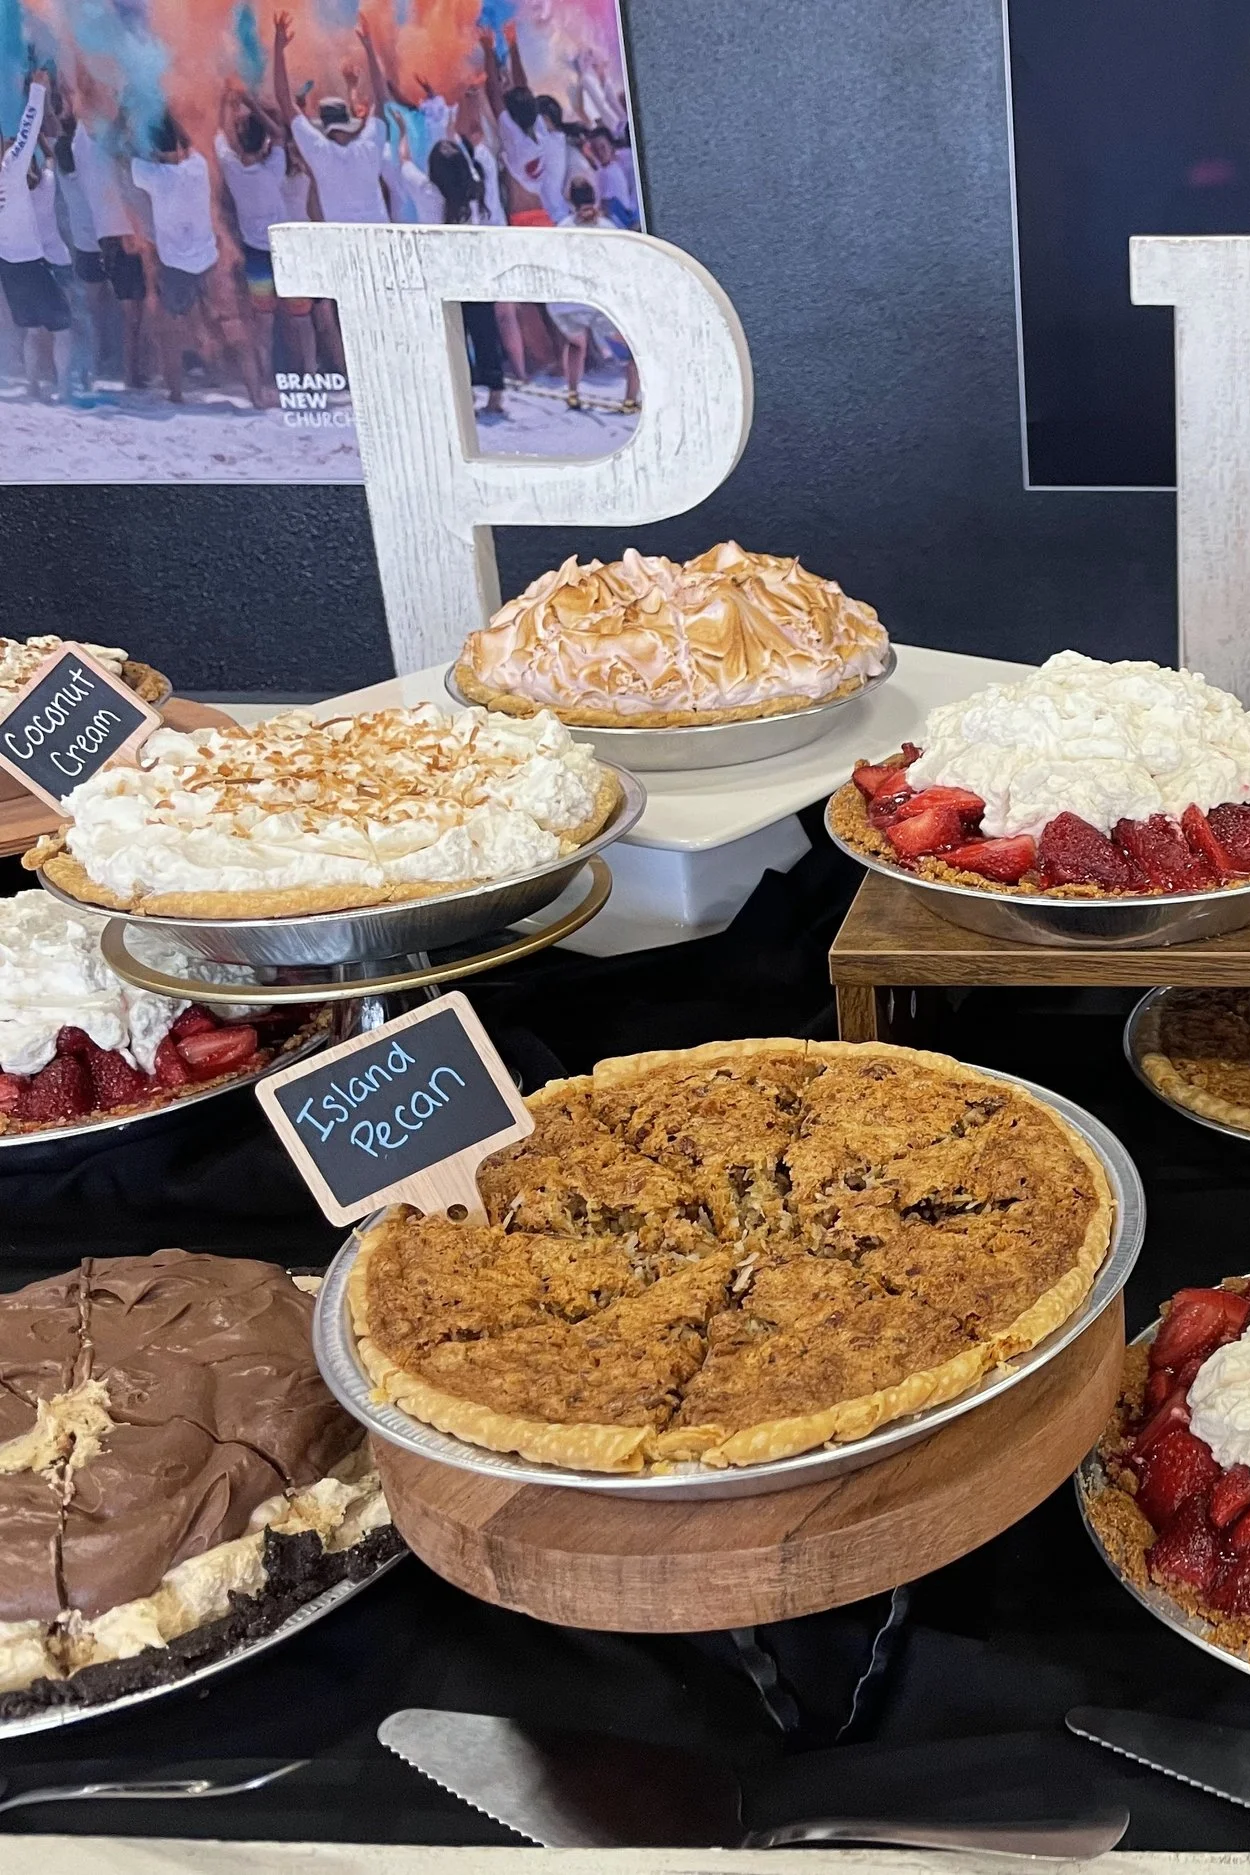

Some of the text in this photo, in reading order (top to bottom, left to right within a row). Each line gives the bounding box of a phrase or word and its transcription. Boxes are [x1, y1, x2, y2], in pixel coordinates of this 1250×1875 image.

[275, 373, 347, 390] BRAND
[279, 392, 328, 409] NEW
[4, 668, 95, 759] Coconut
[50, 709, 121, 777] Cream
[296, 1041, 415, 1142] Island
[351, 1066, 465, 1157] Pecan
